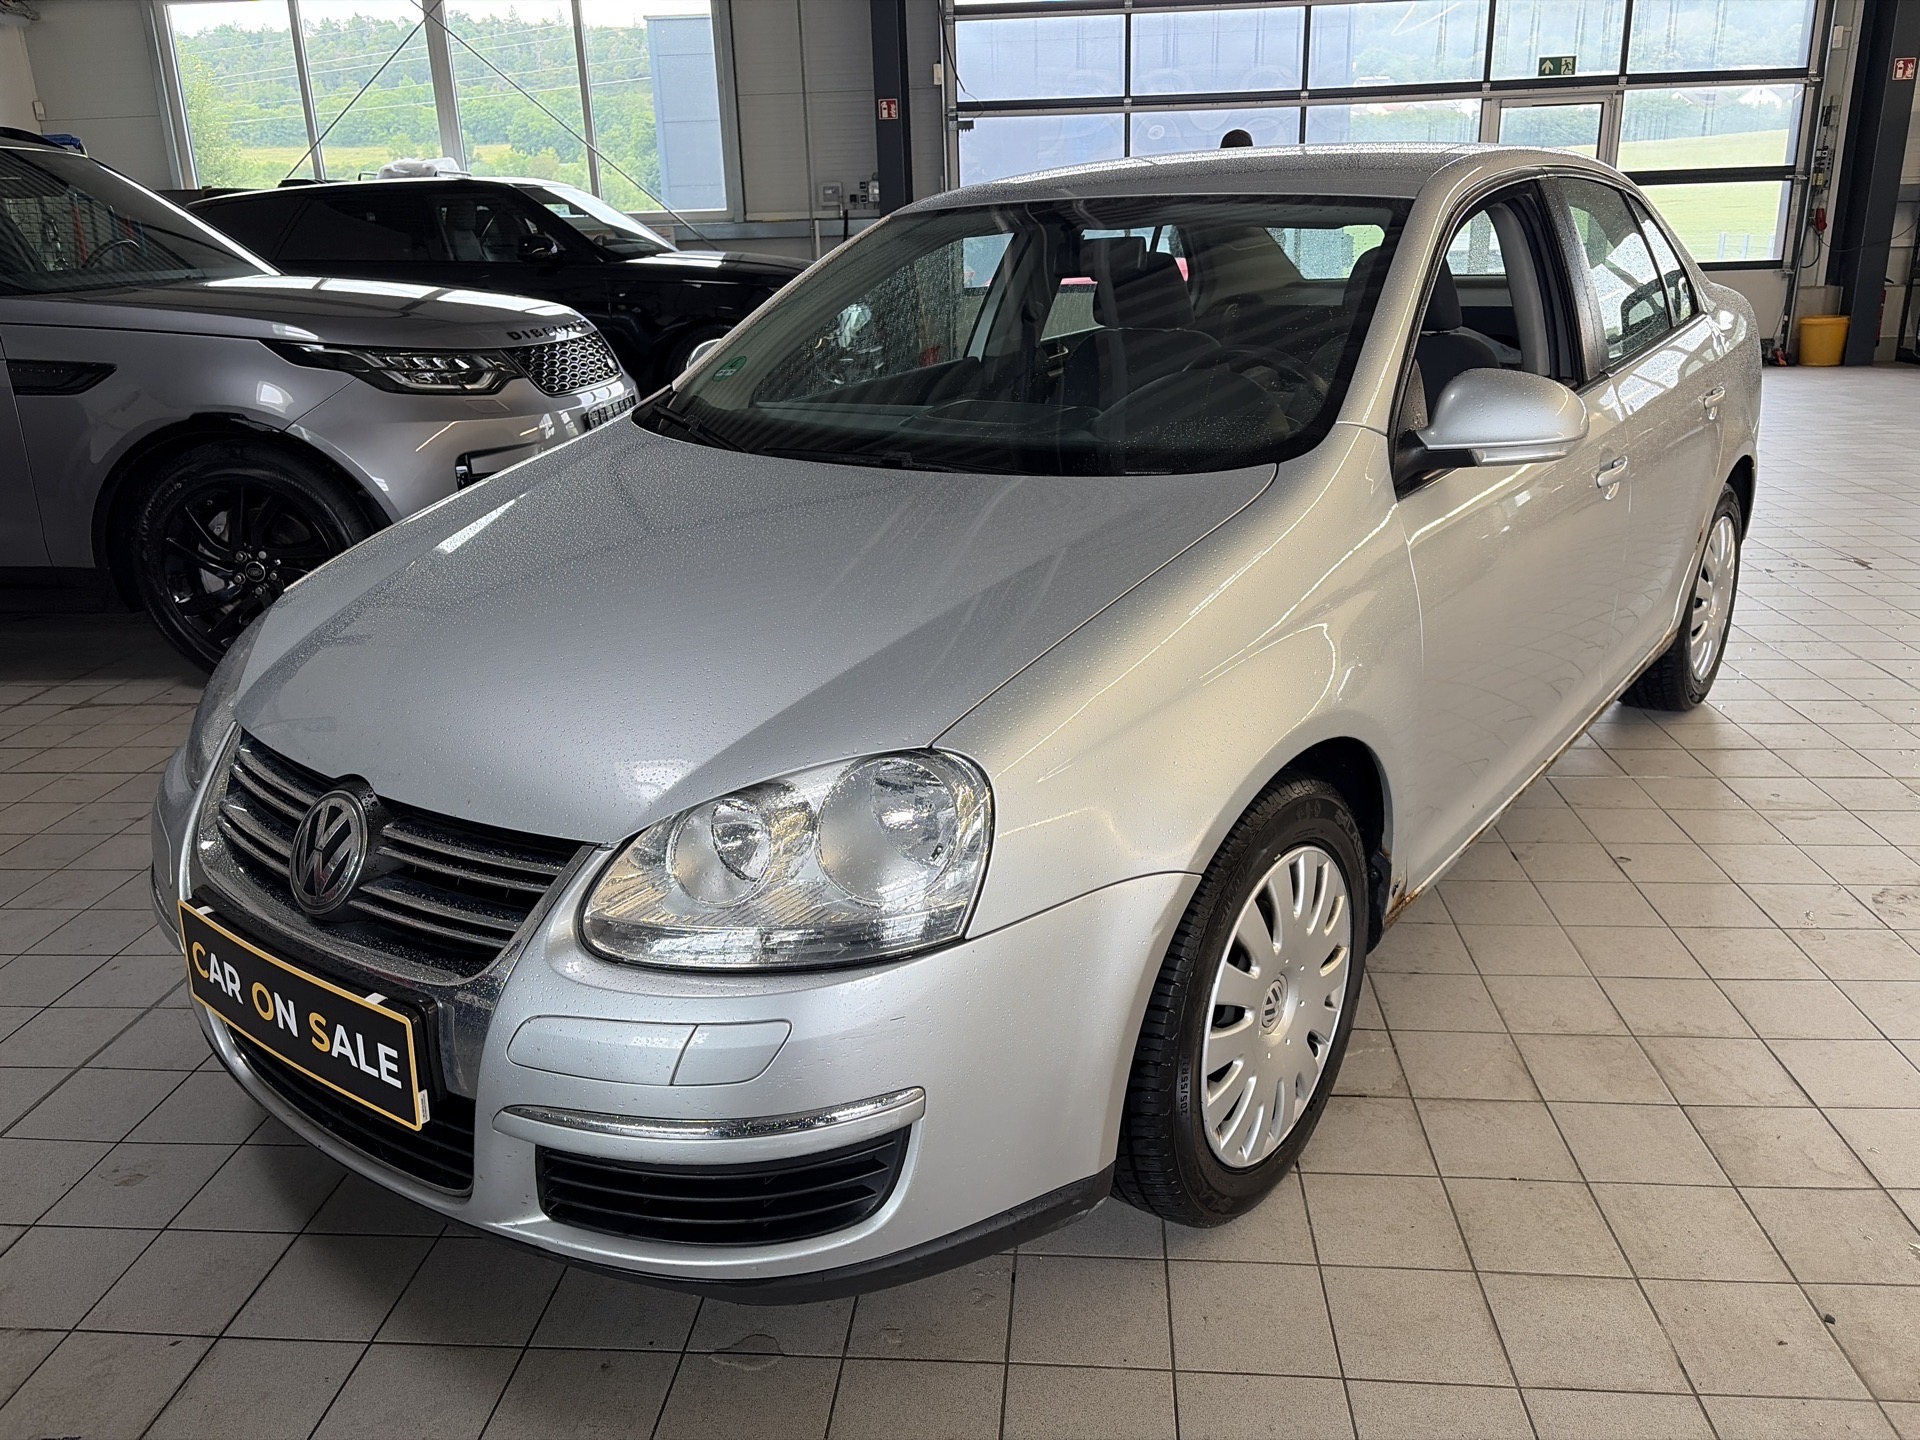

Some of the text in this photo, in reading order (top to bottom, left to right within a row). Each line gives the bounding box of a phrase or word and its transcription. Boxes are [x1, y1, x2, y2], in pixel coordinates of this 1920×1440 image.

[192, 941, 403, 1090] CAR ON SALE
